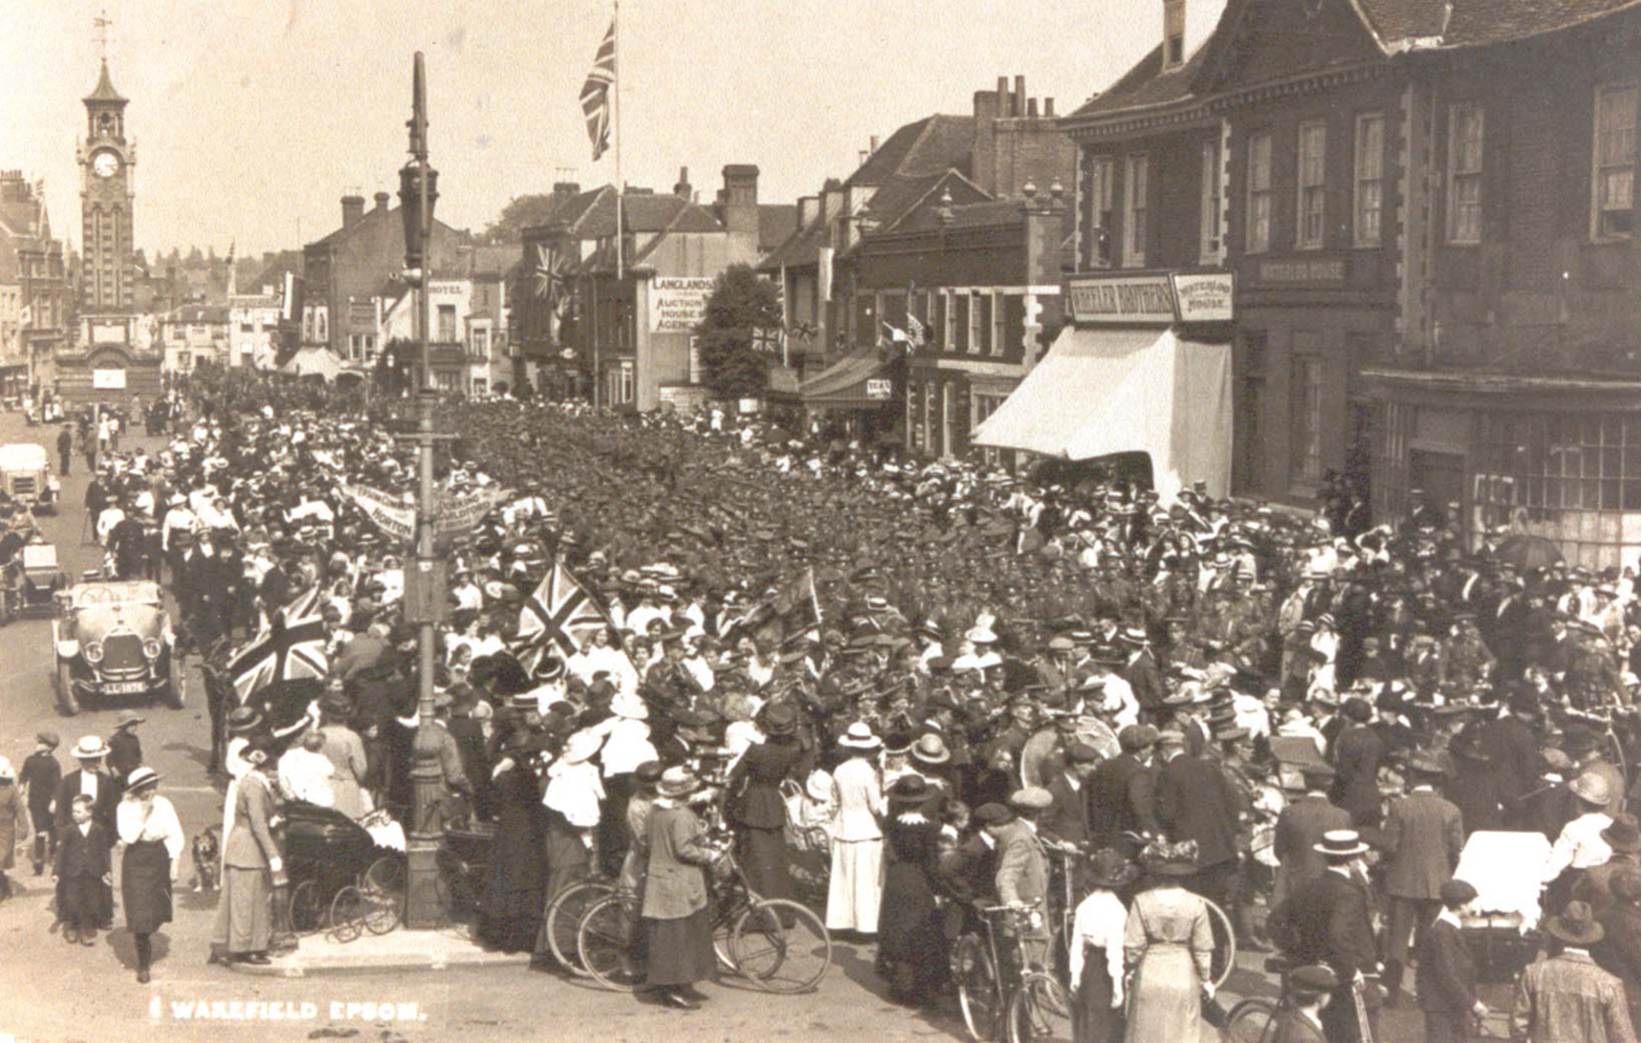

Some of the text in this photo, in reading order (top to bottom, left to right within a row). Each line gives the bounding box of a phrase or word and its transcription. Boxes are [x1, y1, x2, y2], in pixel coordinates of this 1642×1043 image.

[1071, 282, 1174, 314] WHEELER BROTHERS
[372, 507, 412, 536] HORTON
